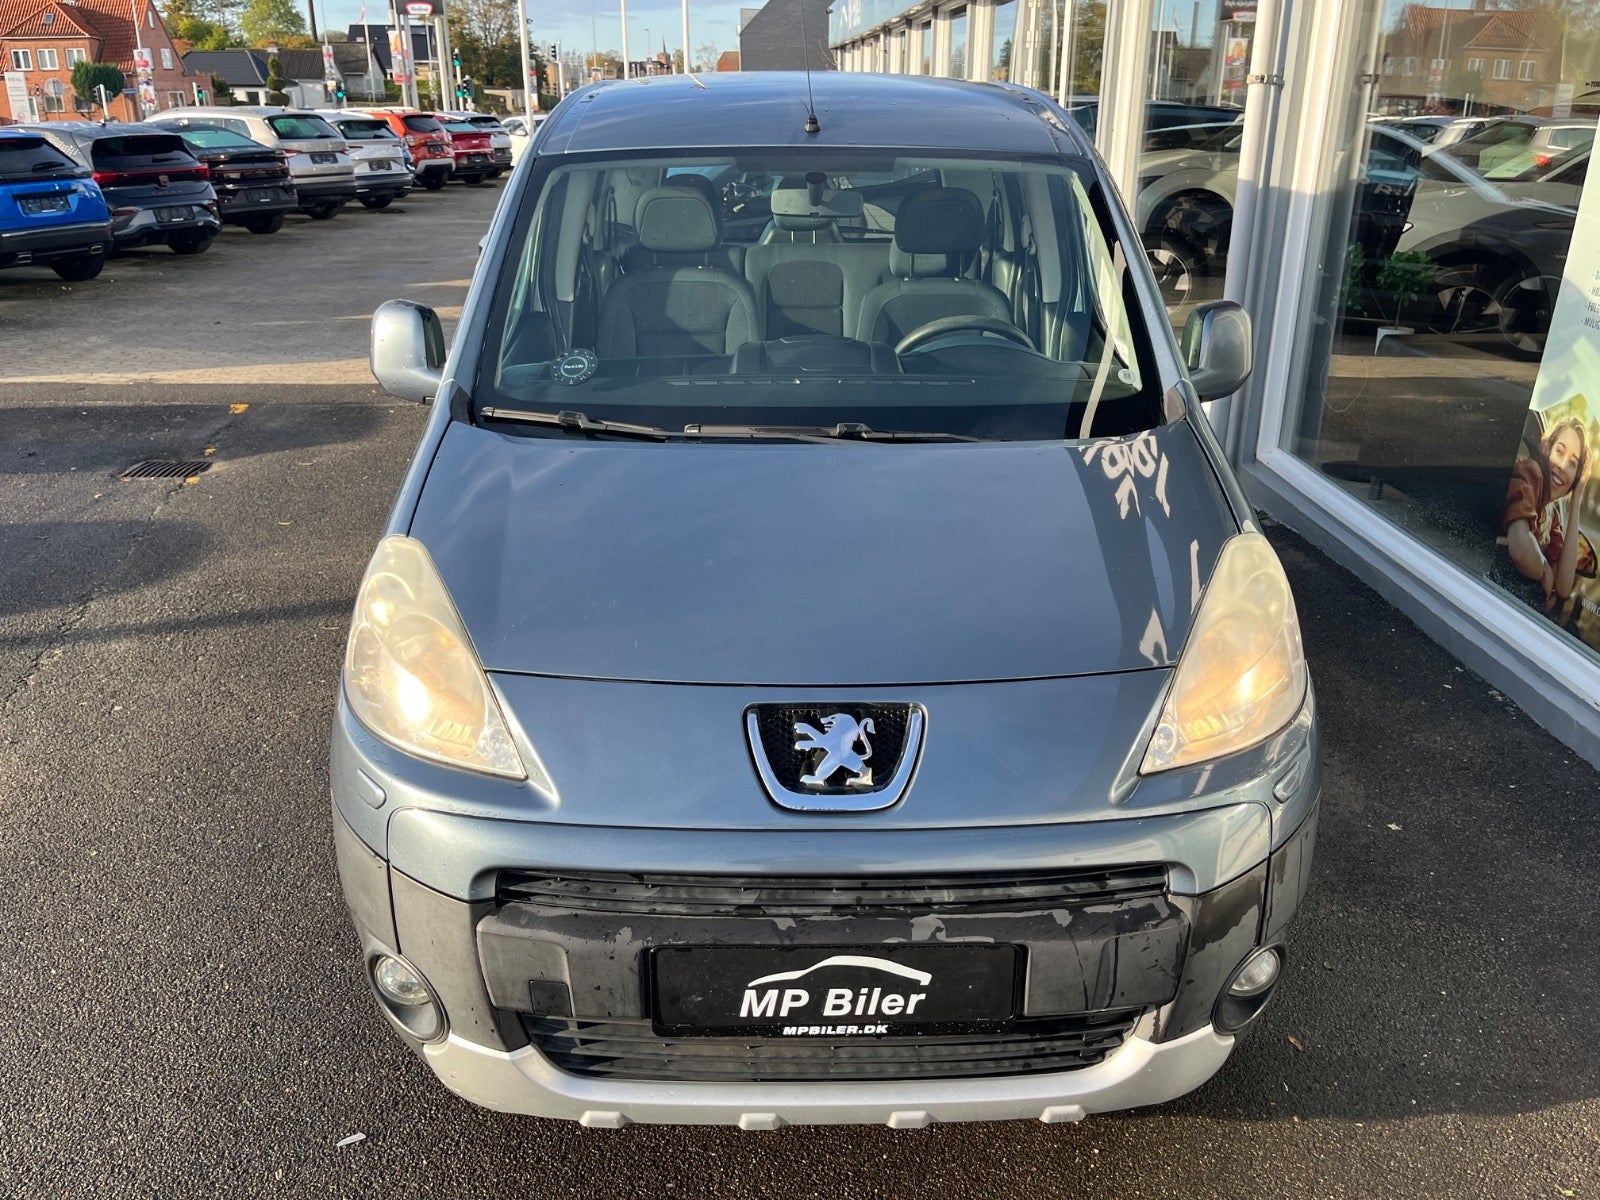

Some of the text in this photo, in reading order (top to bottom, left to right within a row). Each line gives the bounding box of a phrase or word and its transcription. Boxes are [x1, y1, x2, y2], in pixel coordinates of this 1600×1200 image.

[739, 987, 926, 1018] MP Biler
[782, 1024, 889, 1036] MPBILER.DK
